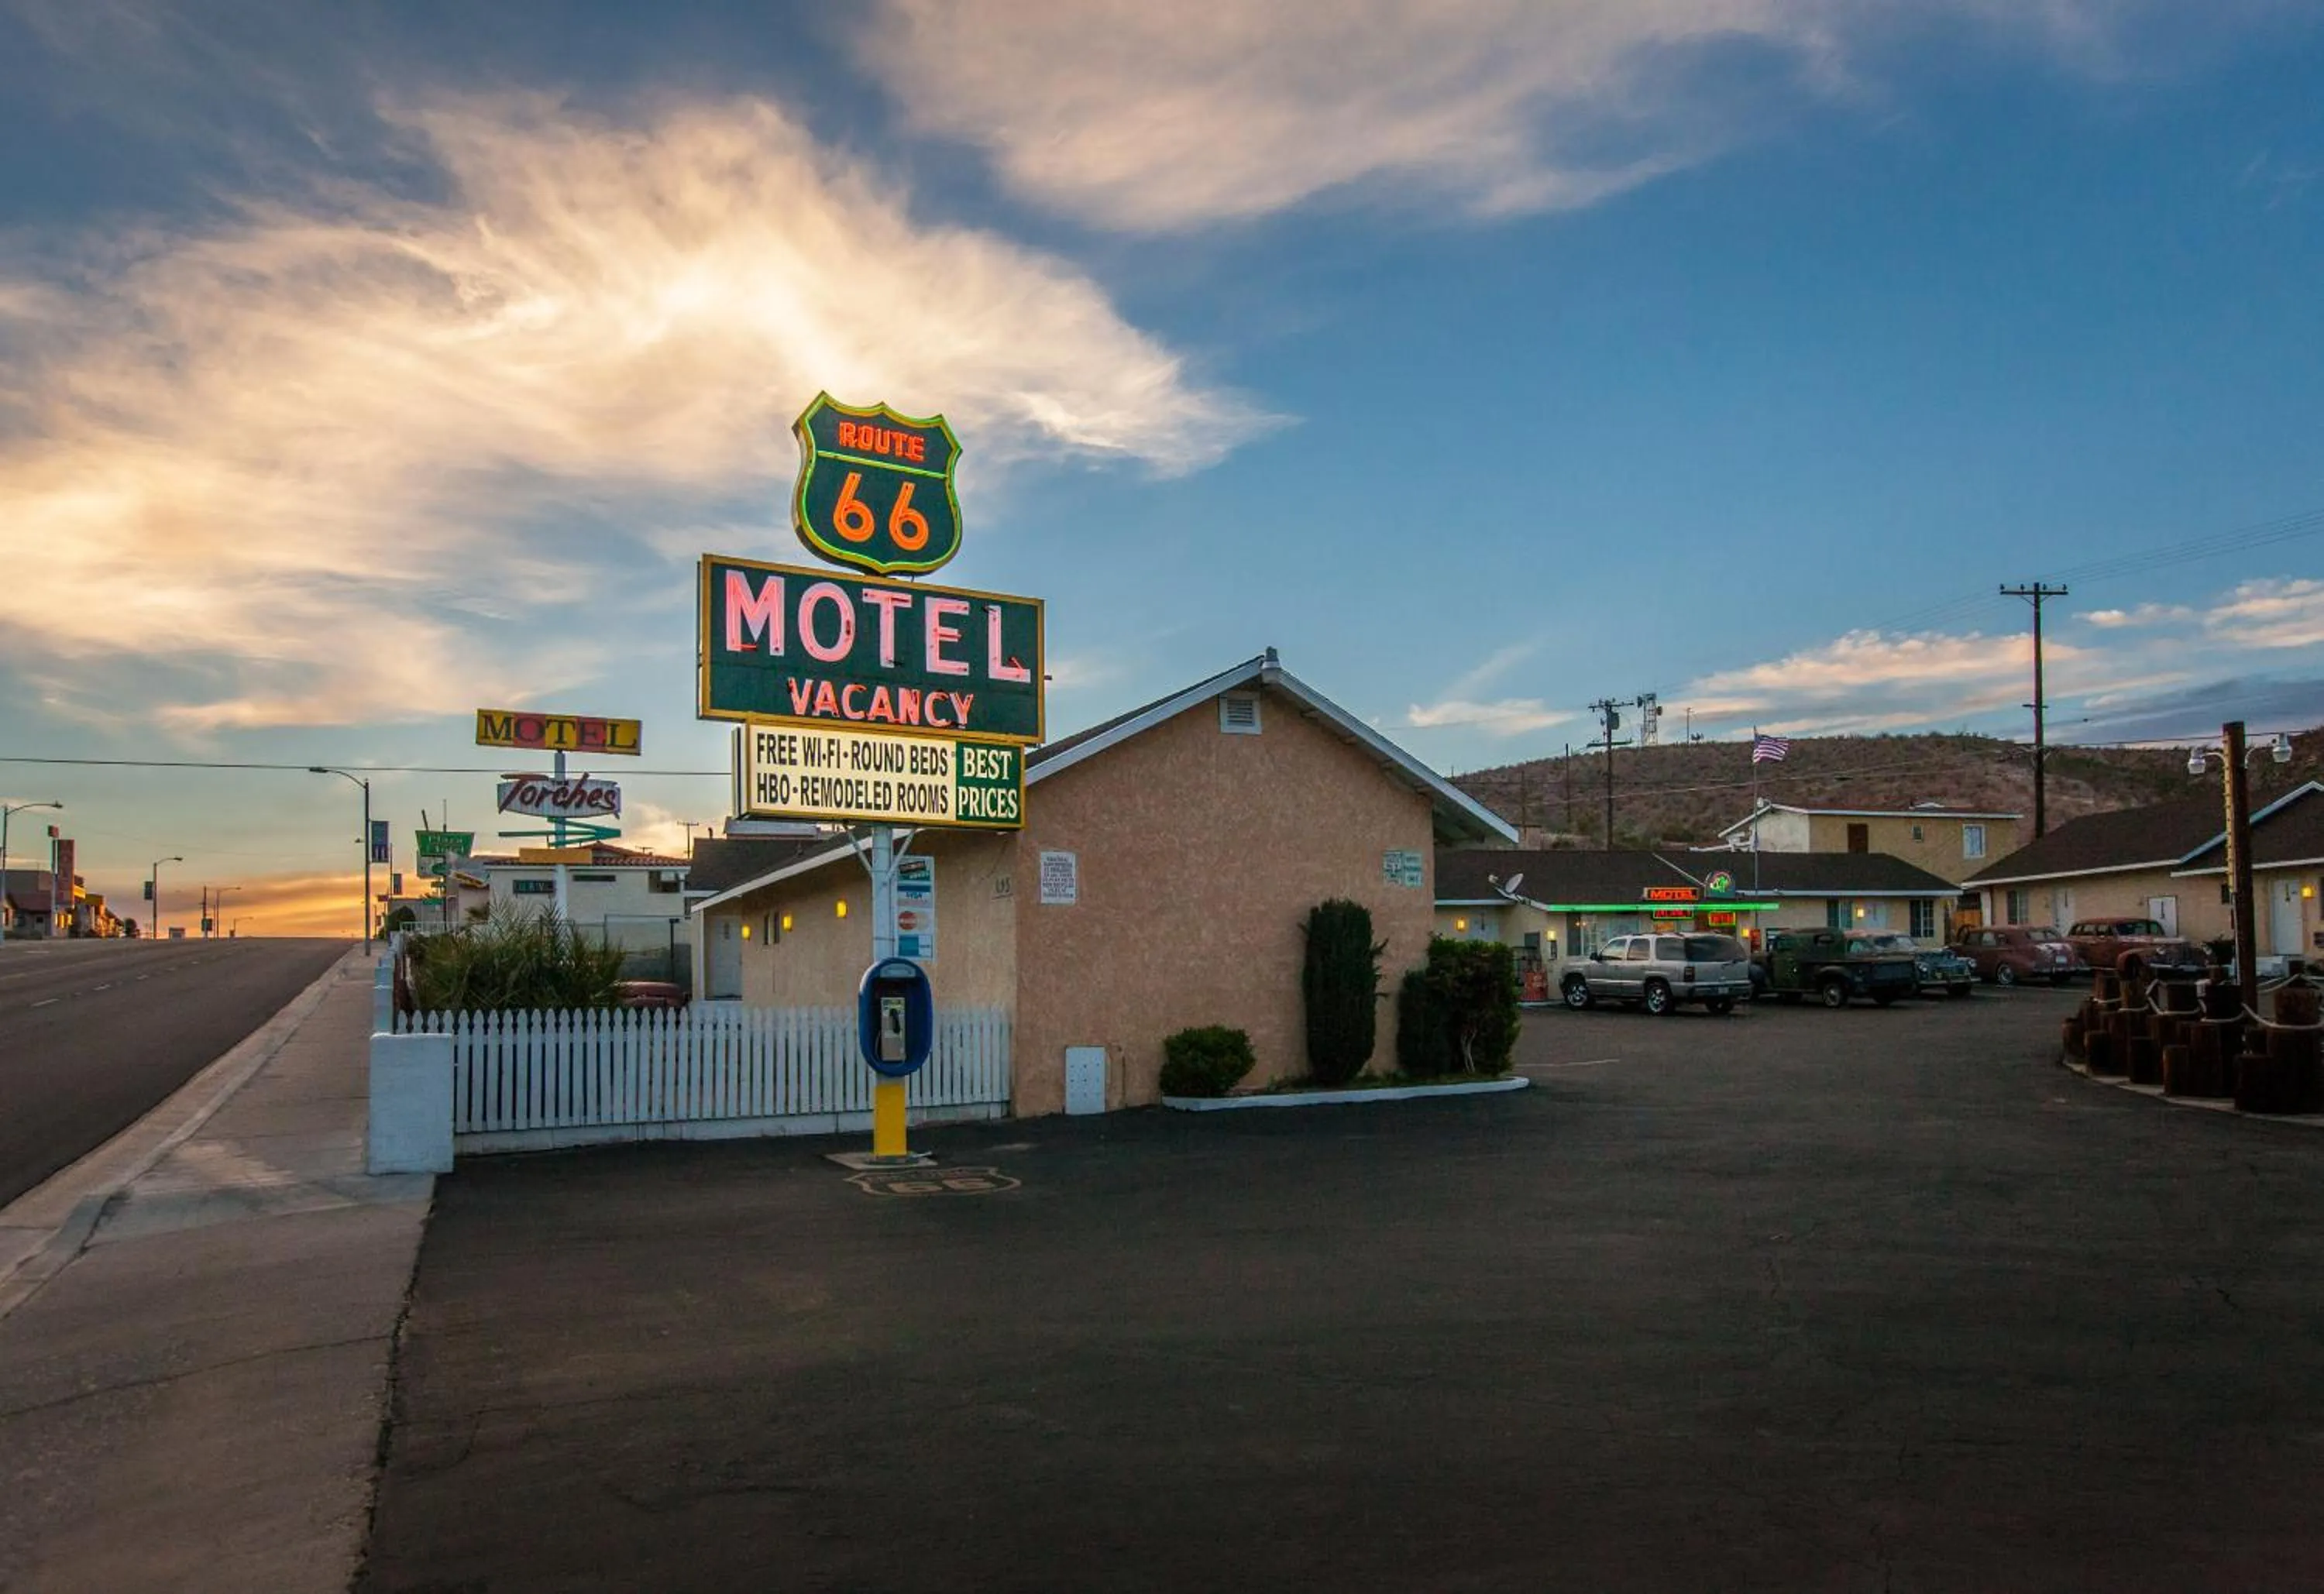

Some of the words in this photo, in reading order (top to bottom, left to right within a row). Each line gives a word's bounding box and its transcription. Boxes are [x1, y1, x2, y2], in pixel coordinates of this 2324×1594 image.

[839, 421, 925, 461] ROUTE
[833, 472, 929, 551] 66
[726, 569, 1031, 683] MOTEL
[788, 677, 974, 729] VACANCY
[481, 713, 638, 749] MOTEL
[756, 733, 797, 766] FREE
[851, 740, 905, 773] ROUND
[910, 744, 948, 776] BEDS
[963, 747, 1012, 780] BEST
[498, 771, 617, 814] Torches
[756, 771, 789, 804] HBO
[800, 775, 892, 811] REMODELED
[897, 782, 948, 814] ROOMS
[957, 785, 1018, 819] PRICES
